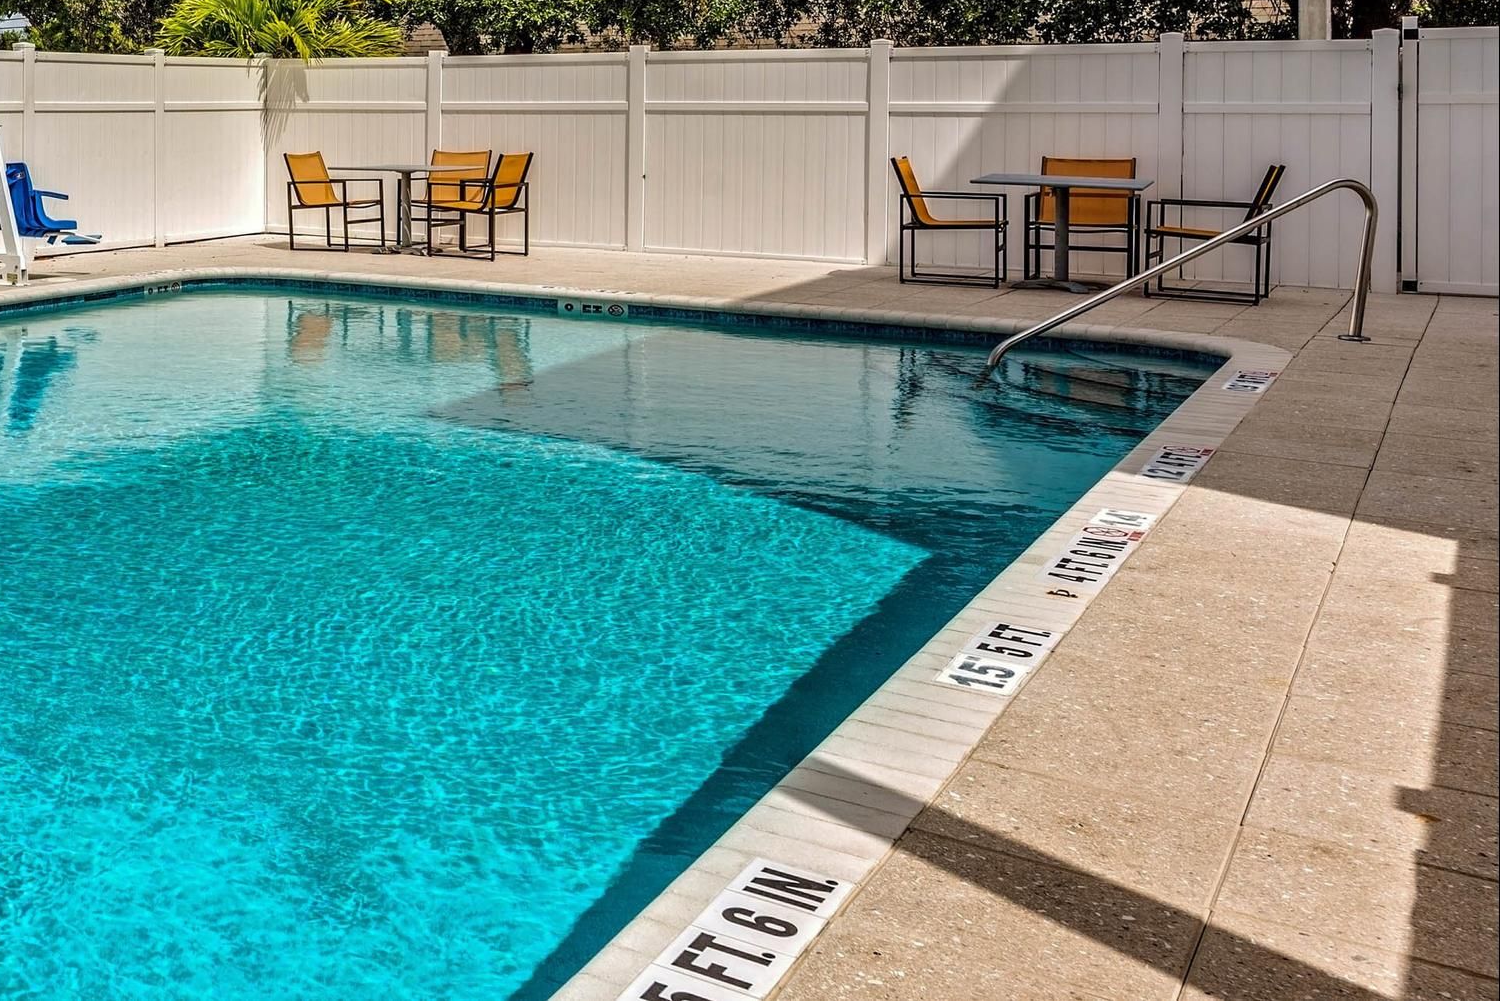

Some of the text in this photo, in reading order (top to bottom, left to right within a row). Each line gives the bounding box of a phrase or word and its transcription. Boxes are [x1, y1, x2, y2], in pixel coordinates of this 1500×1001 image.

[1069, 549, 1117, 560] 6
[1048, 571, 1098, 583] 4
[987, 623, 1052, 647] FT.
[976, 642, 1034, 658] 5
[741, 867, 840, 913] IN.
[721, 907, 799, 938] 6
[670, 932, 777, 991] FT.
